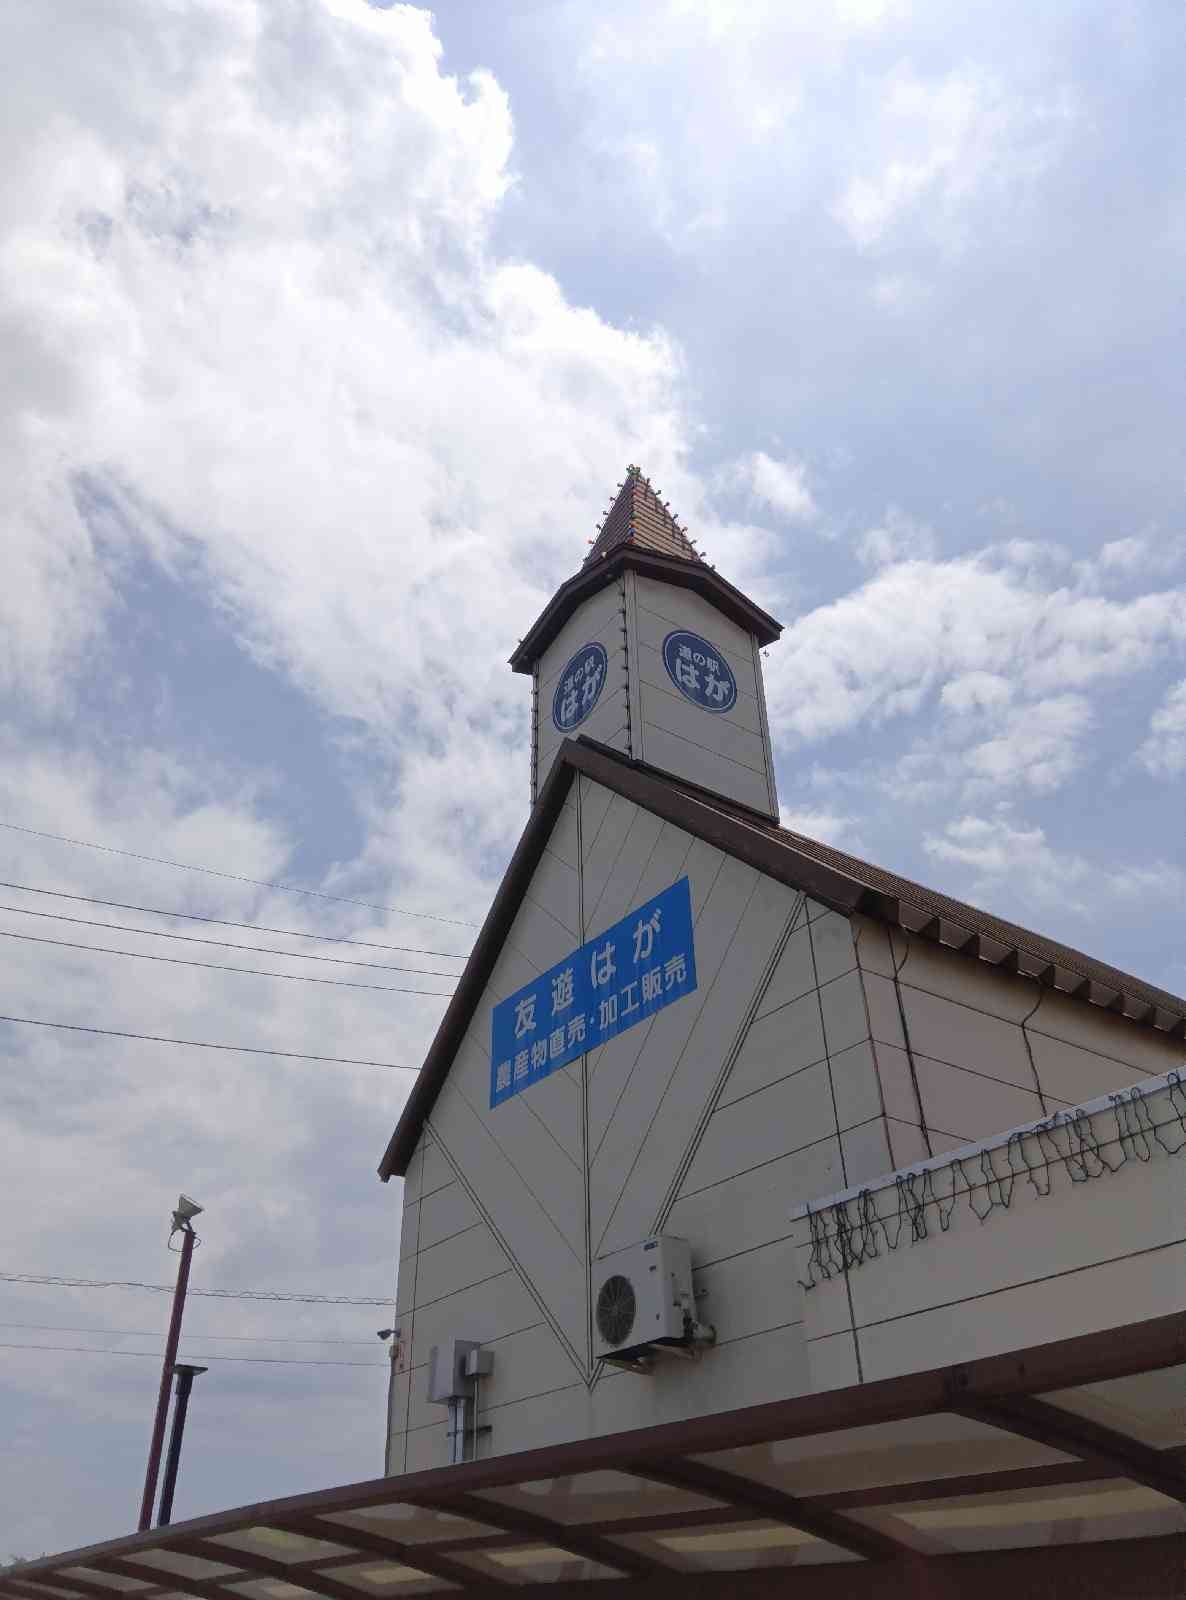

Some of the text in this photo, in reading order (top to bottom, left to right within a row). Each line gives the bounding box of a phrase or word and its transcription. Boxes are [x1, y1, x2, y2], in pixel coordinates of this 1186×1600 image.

[675, 658, 729, 701] はが
[679, 644, 720, 675] 道の駅
[561, 664, 602, 722] はが
